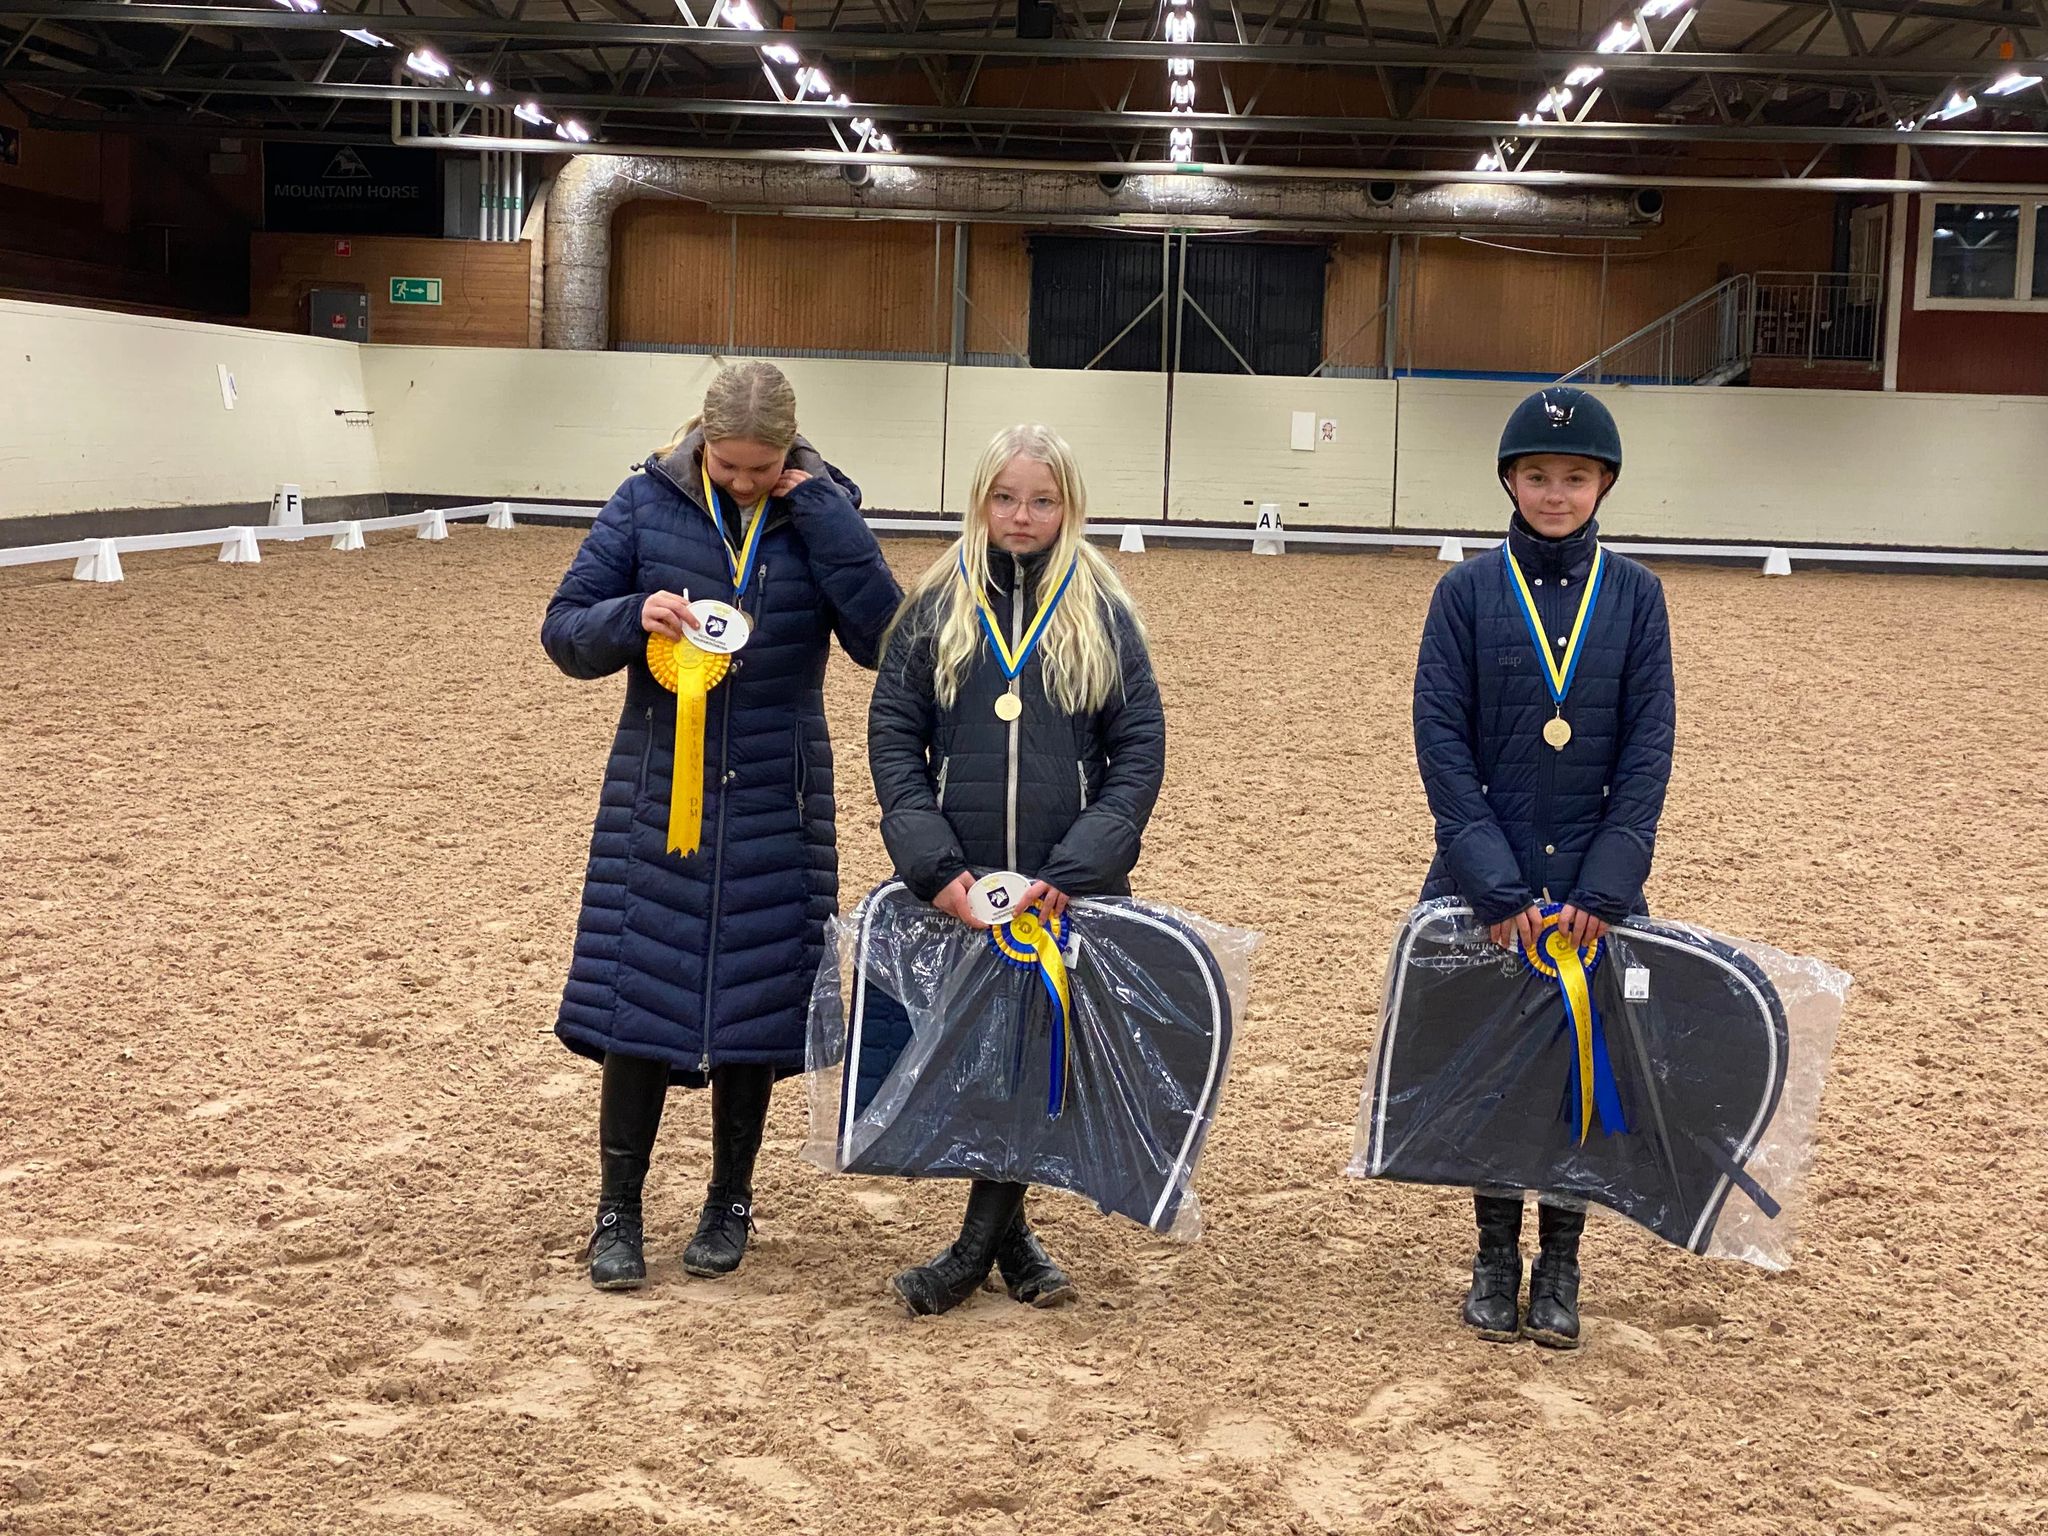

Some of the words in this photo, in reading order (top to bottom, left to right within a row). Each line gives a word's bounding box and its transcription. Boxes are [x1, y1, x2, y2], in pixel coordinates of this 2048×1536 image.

[274, 183, 362, 199] MOUNTAIN
[367, 183, 420, 199] HORSE
[272, 493, 281, 510] F
[287, 494, 297, 511] F
[1259, 513, 1271, 528] A
[1275, 513, 1283, 528] A
